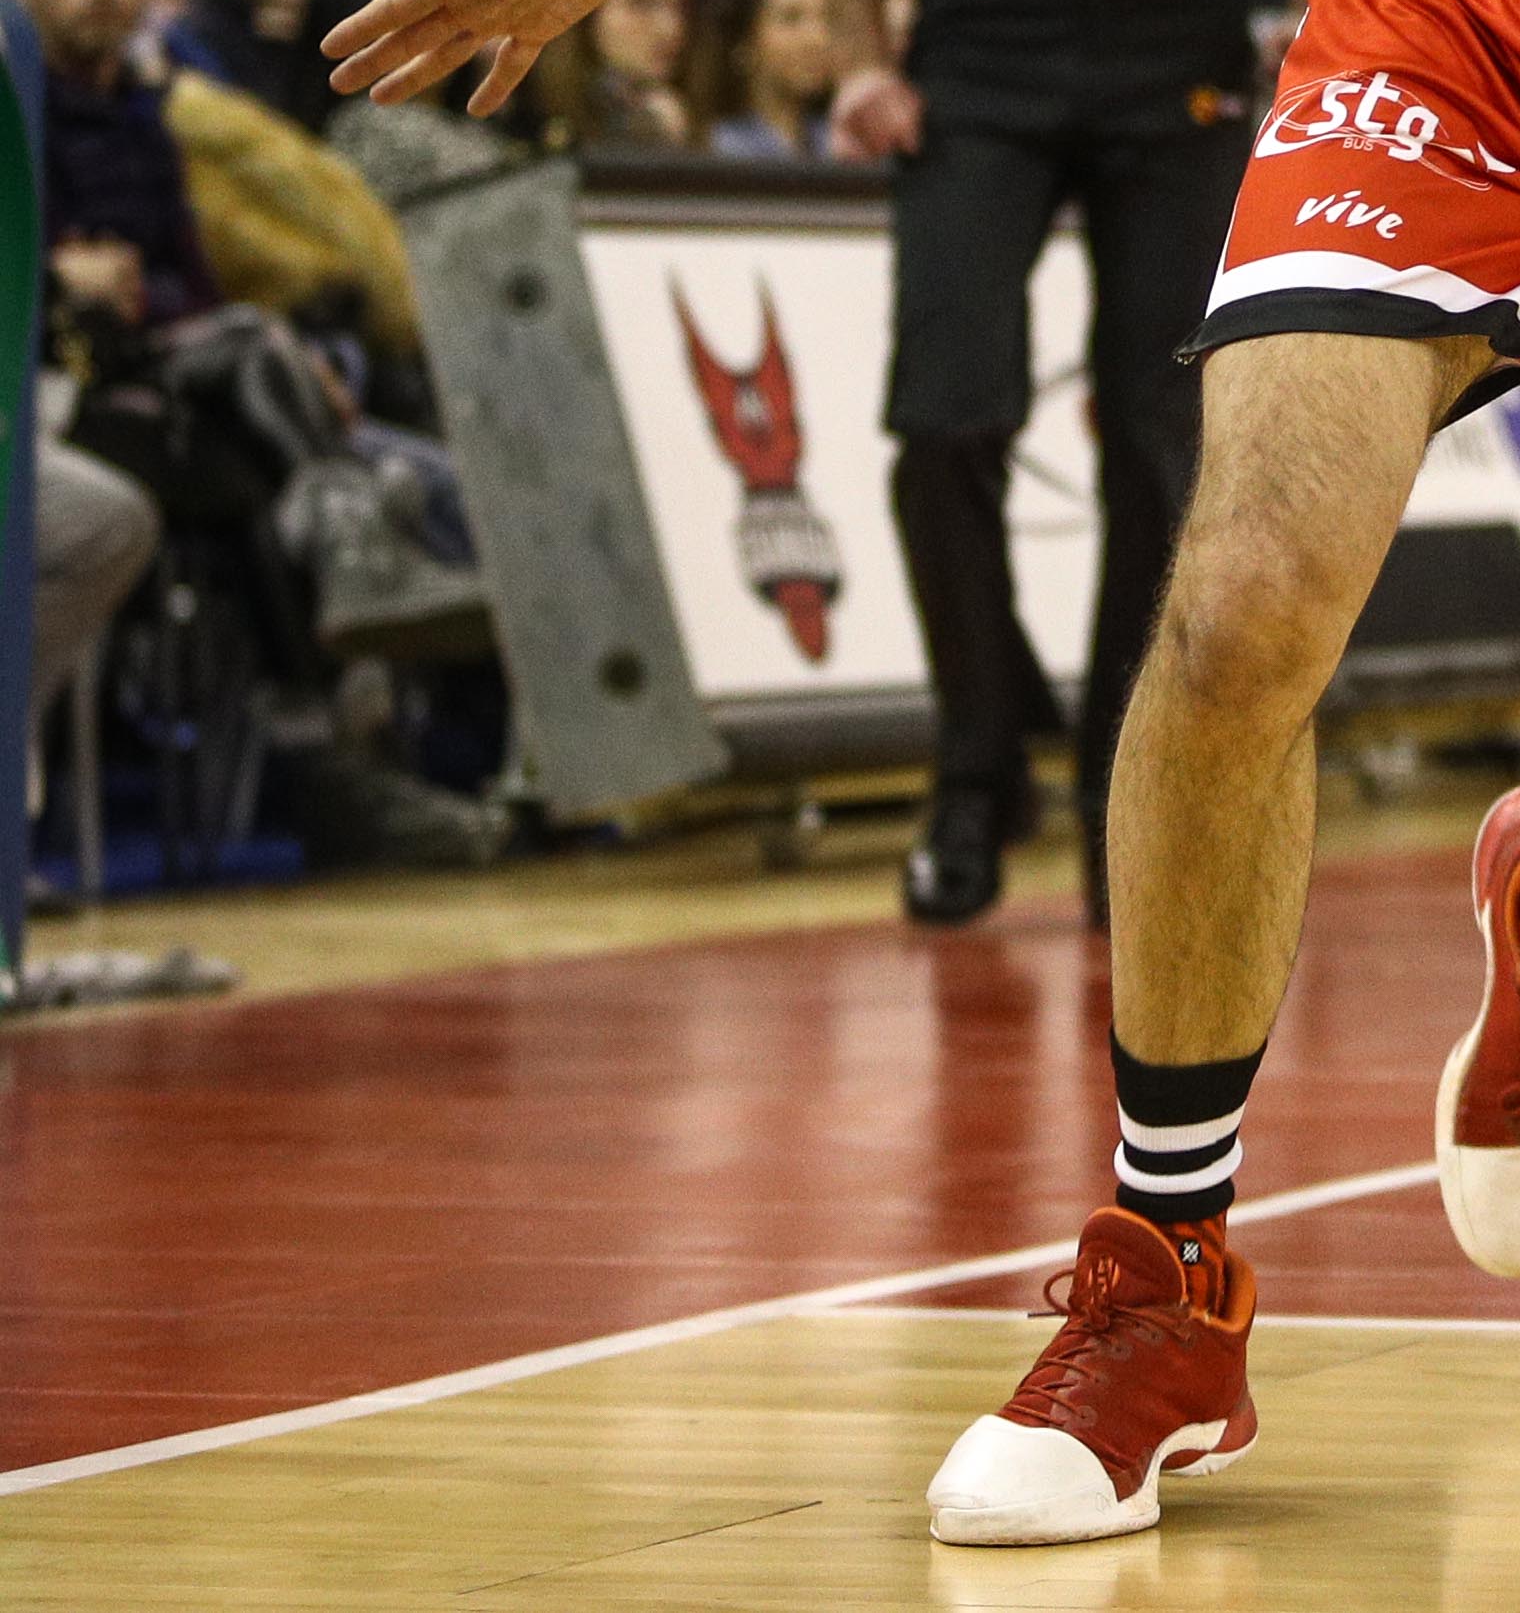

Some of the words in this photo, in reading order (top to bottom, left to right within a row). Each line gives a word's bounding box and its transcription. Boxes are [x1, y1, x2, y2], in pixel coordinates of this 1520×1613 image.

[1306, 72, 1440, 162] stg
[1343, 137, 1374, 152] BUS
[1293, 190, 1404, 239] vive
